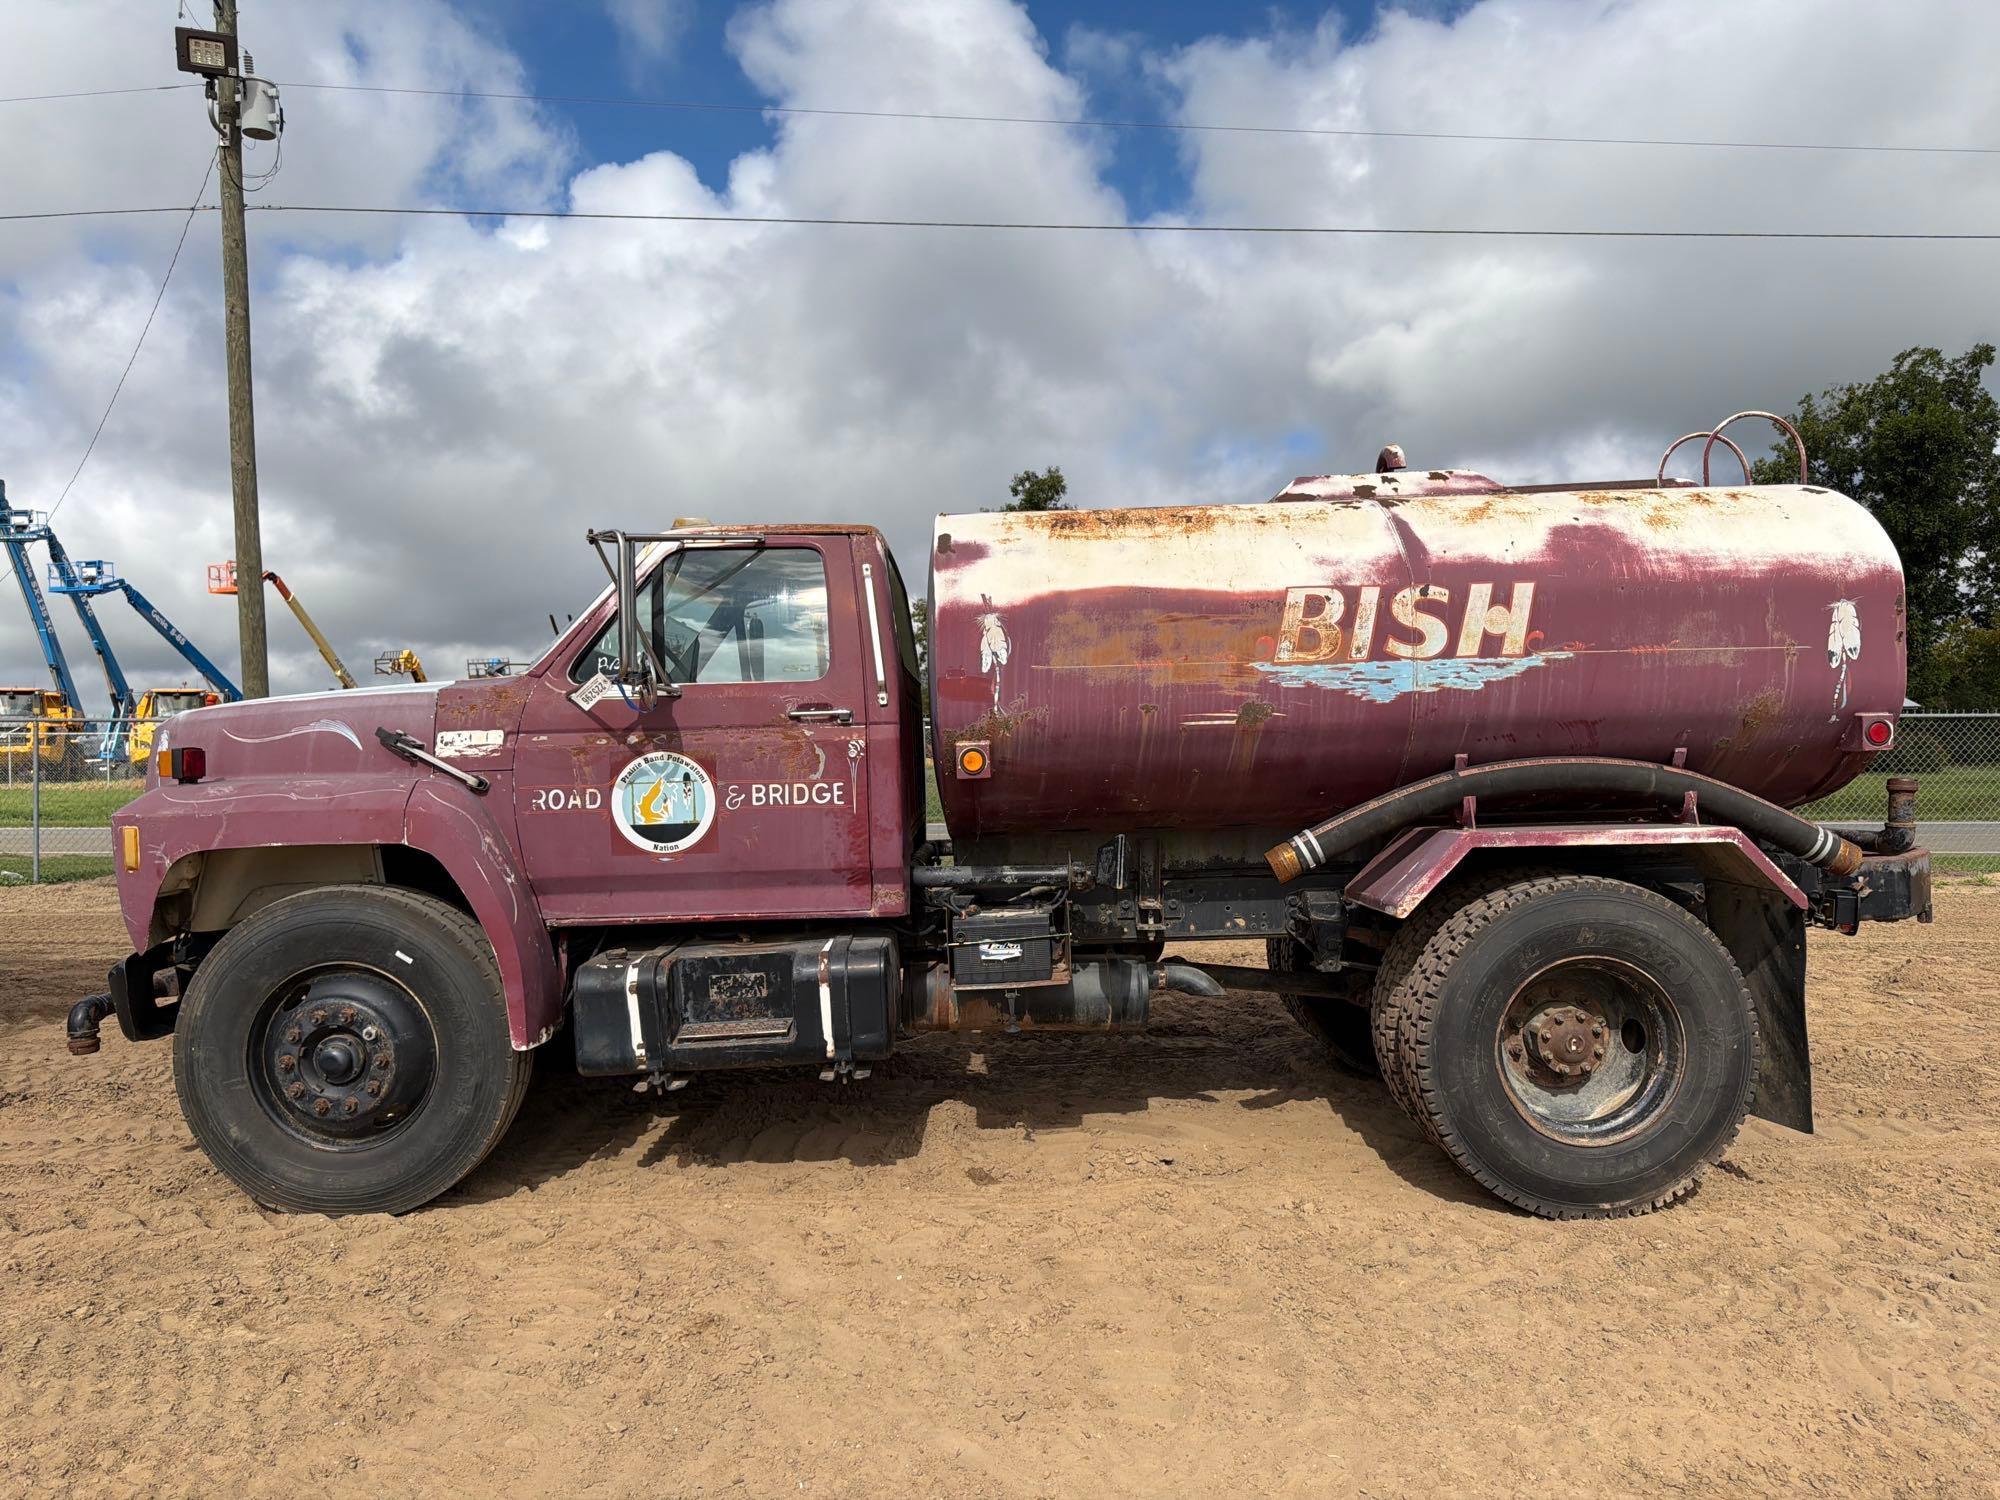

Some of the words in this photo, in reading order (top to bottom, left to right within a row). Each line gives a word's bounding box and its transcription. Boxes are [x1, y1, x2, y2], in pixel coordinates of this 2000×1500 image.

[1273, 580, 1537, 664] BISH
[620, 761, 643, 784] Prairie
[643, 754, 665, 764] Band
[666, 754, 708, 784] Potawatomi
[532, 788, 602, 811] ROAD
[725, 785, 746, 810] &
[751, 782, 845, 806] BRIDGE
[653, 843, 680, 852] Nation
